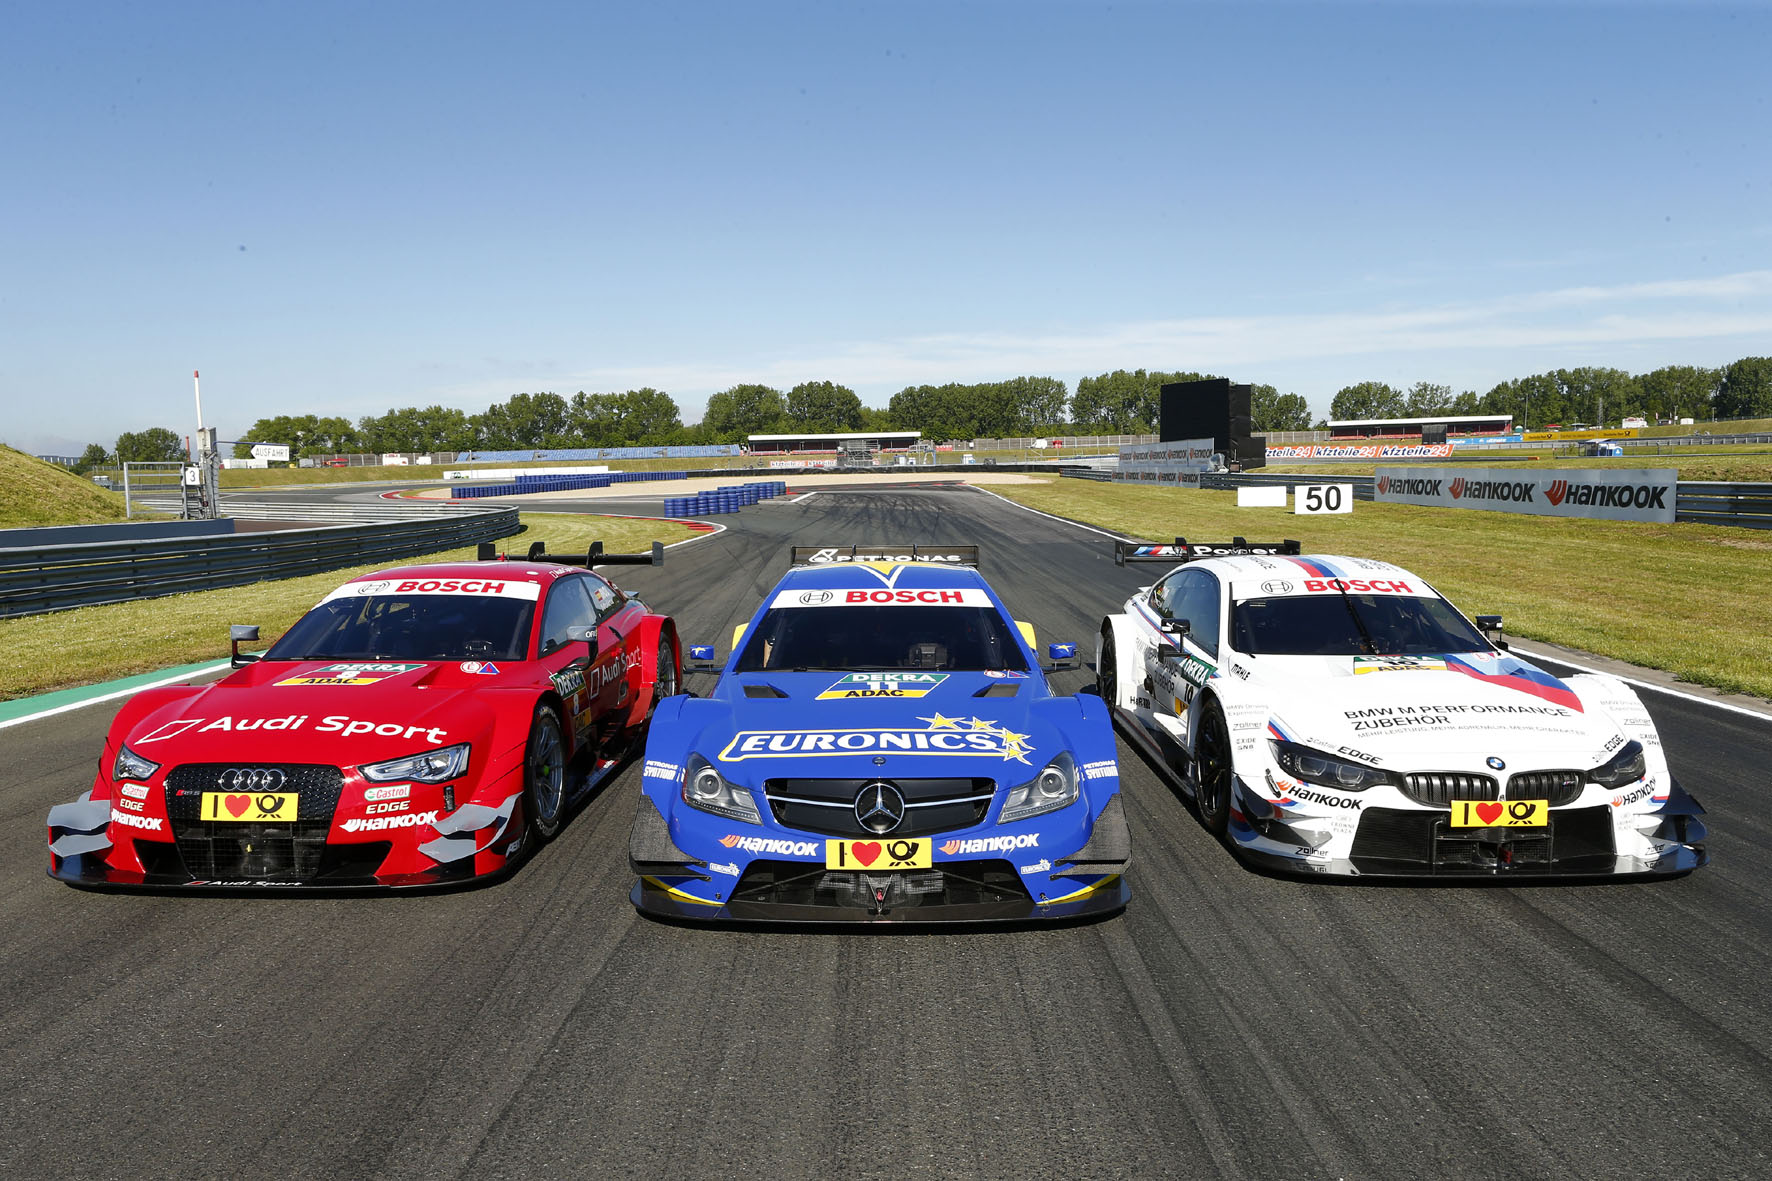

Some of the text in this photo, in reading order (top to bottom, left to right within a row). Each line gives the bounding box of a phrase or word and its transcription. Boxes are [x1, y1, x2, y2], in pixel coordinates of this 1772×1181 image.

[255, 447, 288, 459] AUSFAHRT
[1265, 447, 1311, 458] fzteile24
[1315, 446, 1377, 457] kfzteile24
[1382, 445, 1450, 456] kfzteile24
[189, 470, 196, 482] 3
[1306, 485, 1342, 512] 50
[1194, 545, 1278, 556] Power
[836, 554, 962, 563] PETRONAS
[394, 581, 505, 594] BOSCH
[1304, 579, 1415, 593] BOSCH
[845, 591, 964, 603] BOSCH
[329, 663, 407, 672] DEKRA
[602, 646, 641, 686] Audi Sport
[1184, 659, 1210, 686] DEKRA
[1230, 663, 1251, 681] MAHLE
[335, 671, 361, 679] 8
[852, 674, 937, 682] DEKRA
[557, 671, 582, 697] DEKRA
[866, 681, 899, 690] 11
[845, 689, 904, 697] ADAC
[1184, 683, 1195, 705] 10
[573, 693, 580, 716] 8
[1344, 704, 1573, 719] BMW M PERFORMANCE
[198, 715, 448, 744] Audi Sport
[1351, 715, 1451, 731] ZUBEHÖR
[740, 732, 1000, 752] EURONICS
[1603, 734, 1624, 752] EDGE
[1337, 745, 1384, 765] EDGE
[646, 759, 679, 770] PETRONAS
[1083, 759, 1116, 770] PETRONAS
[643, 765, 677, 781] SYNTIUM
[376, 786, 408, 799] Castrol
[120, 798, 145, 812] EDGE
[213, 794, 219, 818] I
[365, 800, 411, 815] EDGE
[1463, 803, 1469, 826] I
[839, 842, 845, 867] I
[253, 880, 303, 888] Sport
